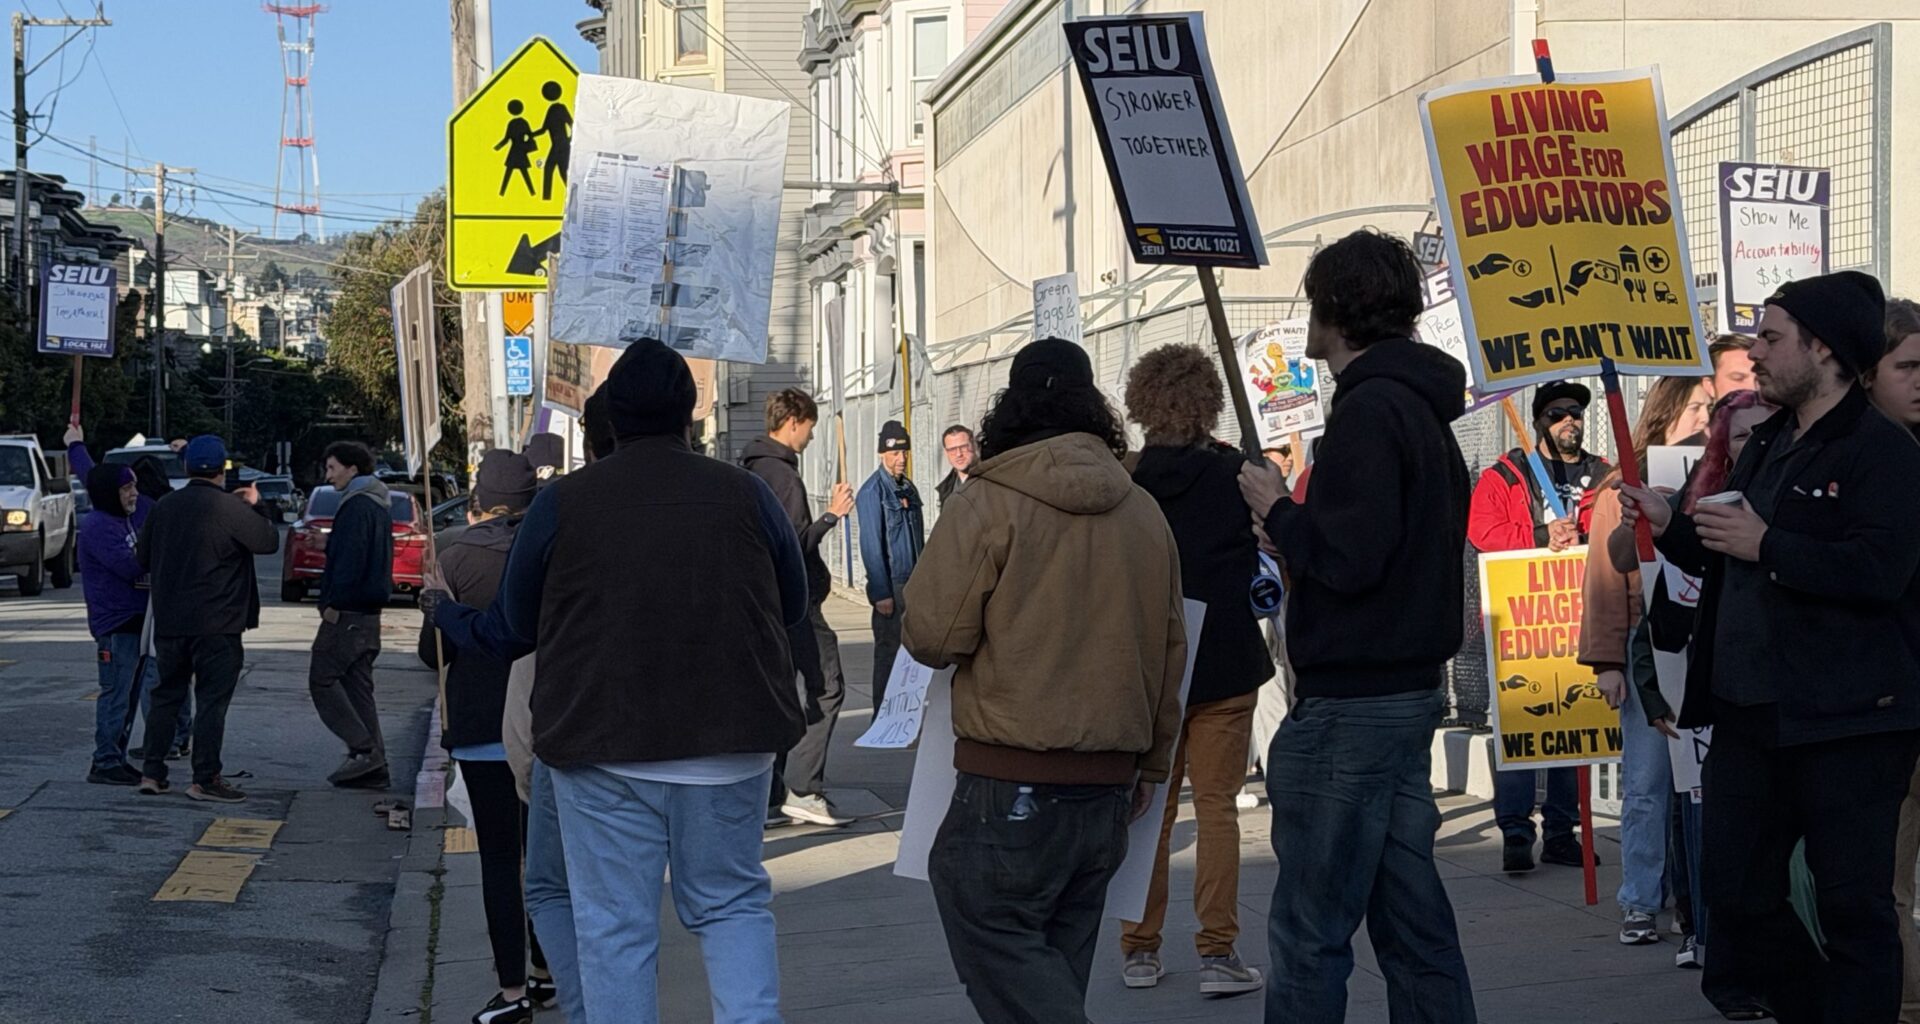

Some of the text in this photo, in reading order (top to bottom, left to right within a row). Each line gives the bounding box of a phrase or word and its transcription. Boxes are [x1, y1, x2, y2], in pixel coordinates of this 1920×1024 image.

[1084, 24, 1181, 73] SEIU
[1105, 87, 1196, 121] STRONGER
[1490, 88, 1609, 138] LIVING
[1120, 135, 1210, 157] TOGETHER
[1465, 134, 1627, 187] WAGE FOR
[1730, 167, 1820, 201] SEIU
[1459, 178, 1672, 238] EDUCATORS
[1740, 206, 1811, 230] Show Me
[1141, 245, 1166, 256] SEIU
[1169, 235, 1241, 253] LOCAL 1021
[1735, 240, 1821, 264] Accountability
[49, 264, 109, 285] SEIU
[1034, 282, 1070, 304] Green
[1035, 303, 1064, 333] Eggs
[1735, 315, 1755, 327] SEIU
[1481, 322, 1693, 374] WE CAN'T WAIT
[1502, 732, 1536, 758] WE
[1541, 728, 1599, 755] CAN'T
